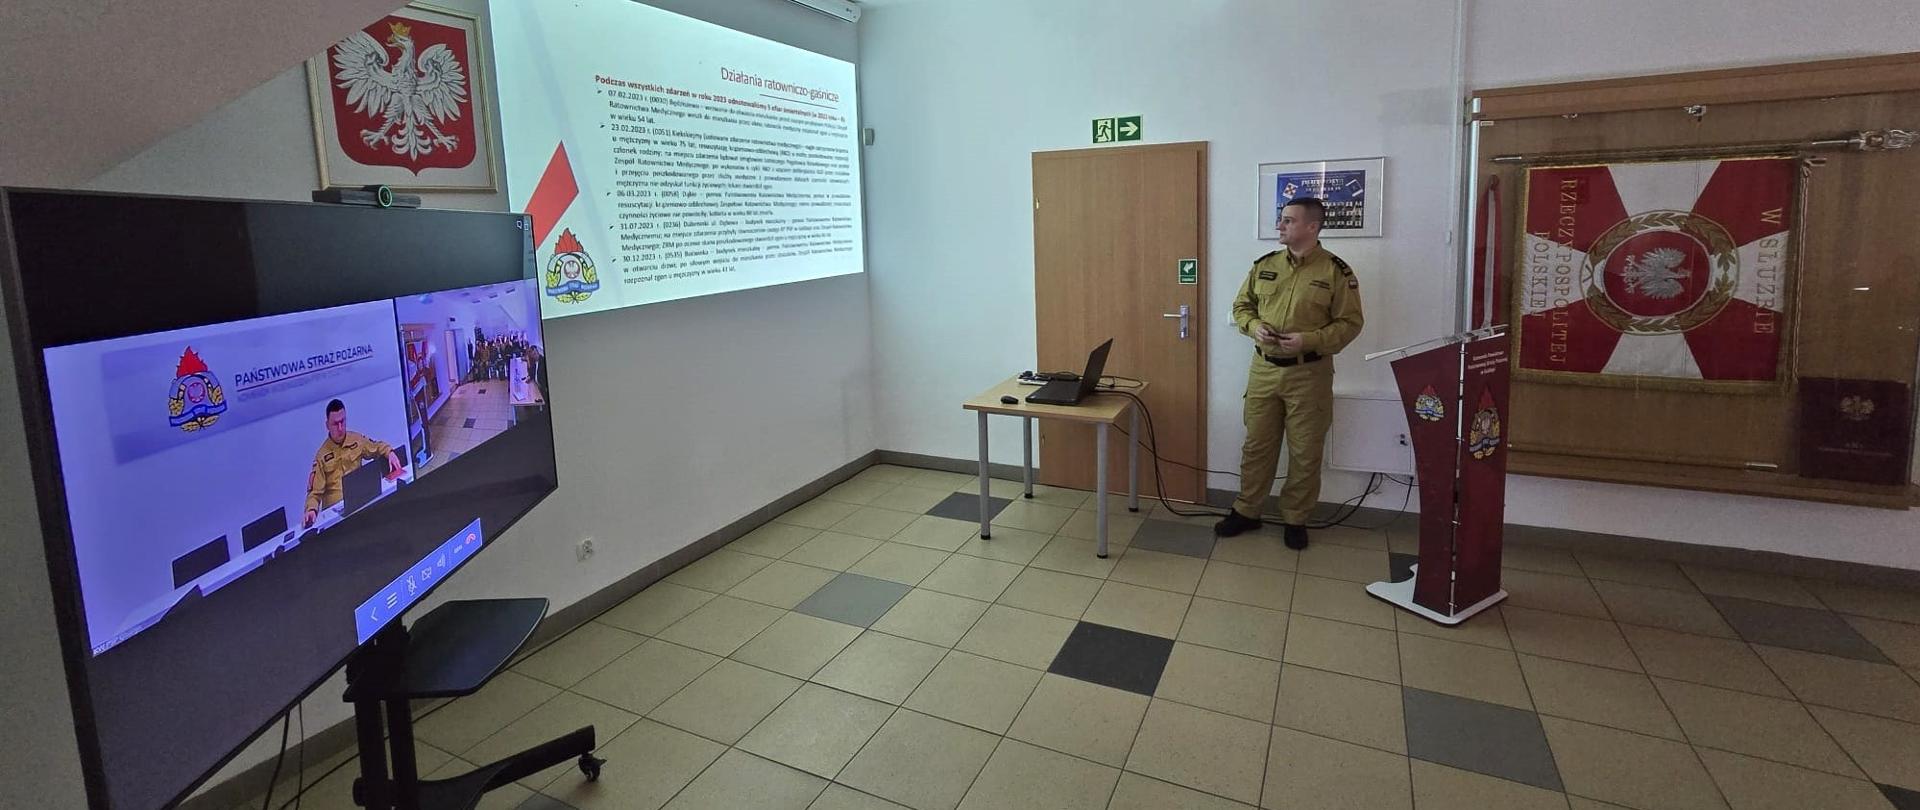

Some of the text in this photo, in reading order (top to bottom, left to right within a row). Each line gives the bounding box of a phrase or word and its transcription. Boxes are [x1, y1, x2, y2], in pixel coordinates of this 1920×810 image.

[595, 75, 626, 87] Podczas
[628, 80, 664, 96] wszystkich
[666, 87, 690, 98] zdarzeń
[698, 92, 712, 101] roku
[713, 95, 726, 104] 2023
[720, 67, 839, 102] Działania ratowniczo-gaśnicze
[608, 88, 643, 101] 07.02.2023
[609, 100, 649, 112] Ratownictwa
[651, 106, 685, 118] Medycznego
[618, 112, 636, 121] wieku
[611, 123, 646, 133] 23.02.2023
[652, 127, 671, 137] (0051)
[619, 134, 650, 145] mężczyzny
[613, 145, 637, 154] członek
[614, 156, 635, 166] Zespół
[638, 158, 674, 166] Ratownictwa
[621, 168, 649, 177] przejęciu
[652, 169, 699, 179] poszkodowanego
[616, 179, 648, 187] mężczyzna
[660, 180, 683, 188] odzyskał
[618, 211, 648, 220] czynności
[1760, 208, 1782, 224] W
[623, 253, 655, 261] 30.12.2023
[632, 263, 658, 271] otwarciu
[1550, 179, 1578, 364] RZECZYPOSPOLITEJ
[624, 274, 653, 284] rozpoznał
[1530, 231, 1550, 319] POLSKIEJ
[235, 359, 306, 386] PAŃSTWOWA
